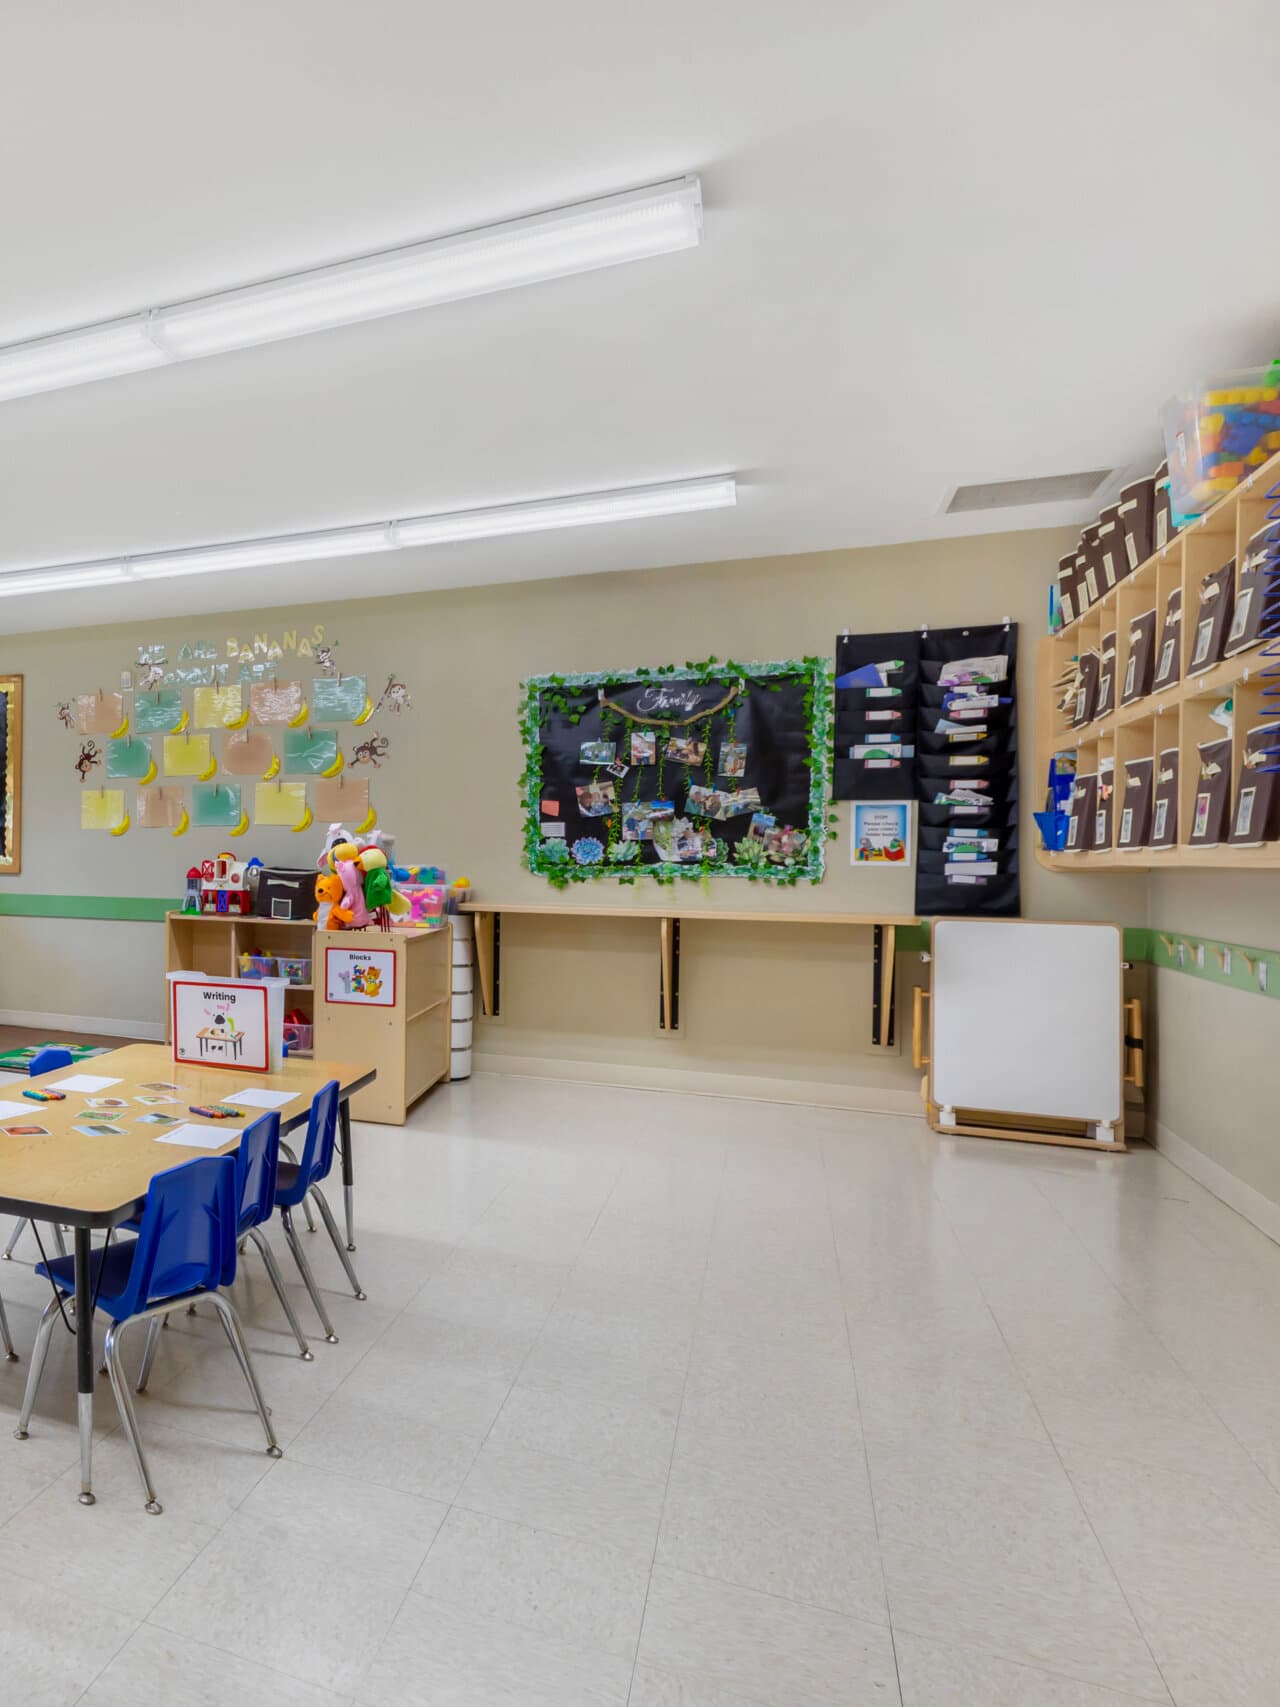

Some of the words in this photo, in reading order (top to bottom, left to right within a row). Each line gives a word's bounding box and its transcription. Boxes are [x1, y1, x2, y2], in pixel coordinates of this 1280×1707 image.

[177, 640, 217, 660] ARE
[225, 624, 325, 664] BANANAS
[349, 953, 372, 961] Blocks
[203, 991, 236, 1004] Writing
